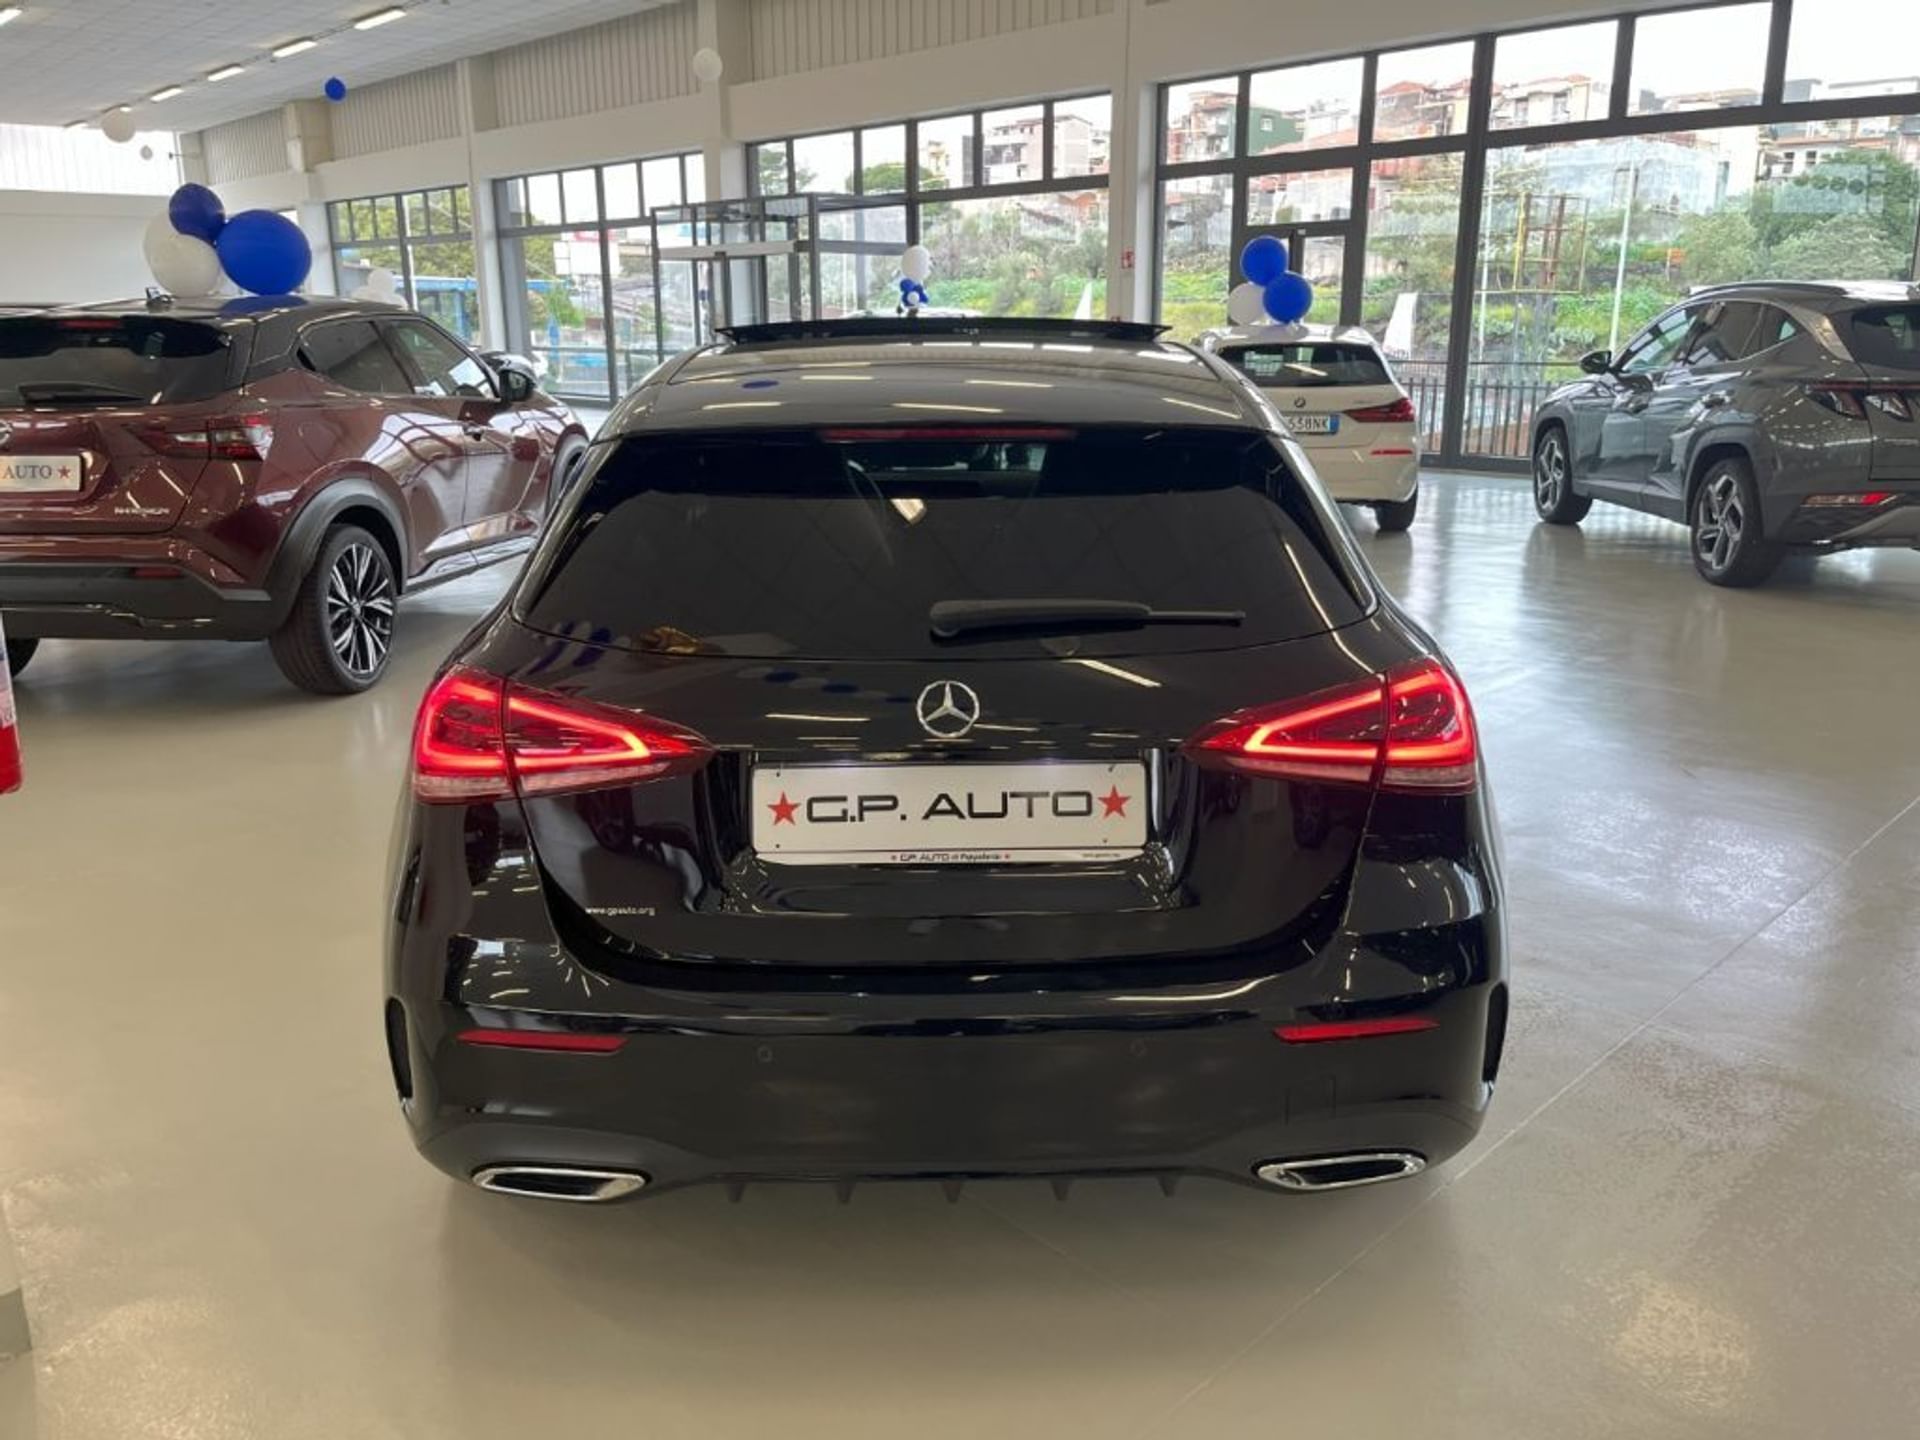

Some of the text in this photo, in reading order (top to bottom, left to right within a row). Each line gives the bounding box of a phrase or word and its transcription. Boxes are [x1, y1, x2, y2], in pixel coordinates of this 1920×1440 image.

[3, 465, 52, 479] AUTO
[806, 791, 1093, 823] G.P. AUTO
